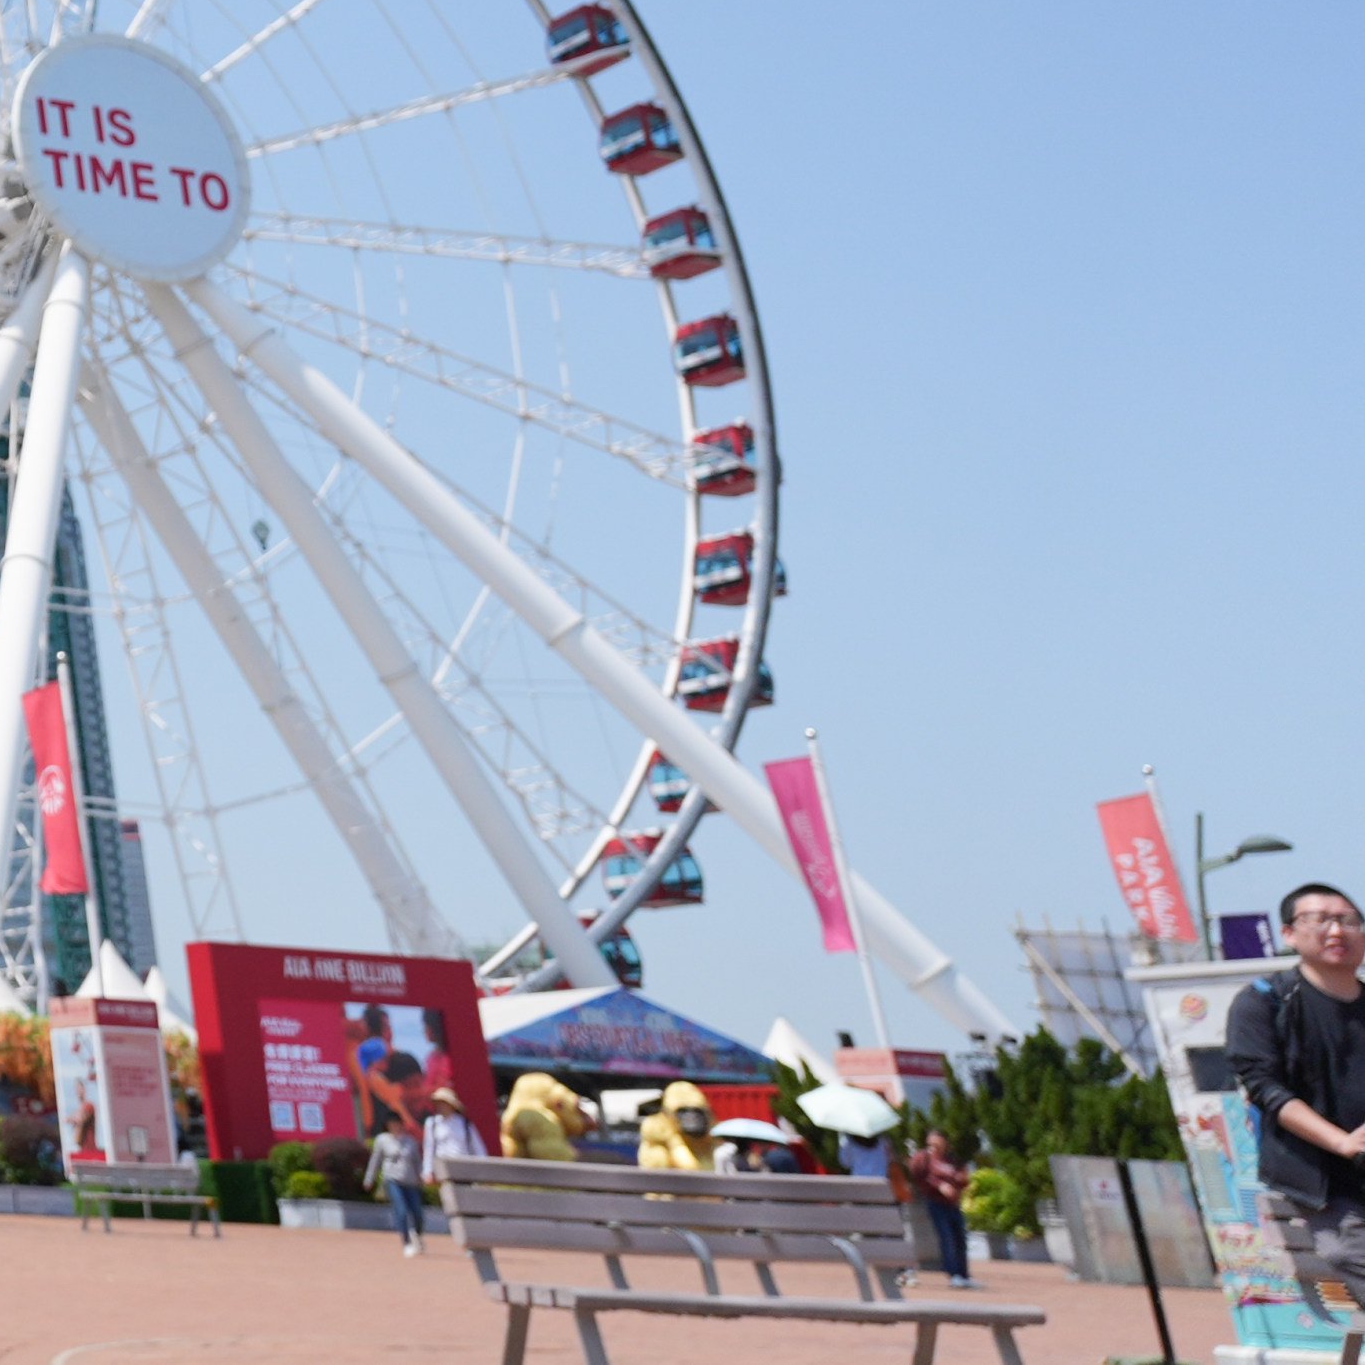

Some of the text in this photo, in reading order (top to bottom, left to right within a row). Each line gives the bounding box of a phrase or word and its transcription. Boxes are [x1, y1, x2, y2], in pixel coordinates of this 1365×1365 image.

[36, 96, 137, 148] IT IS
[42, 147, 231, 212] TIME TO
